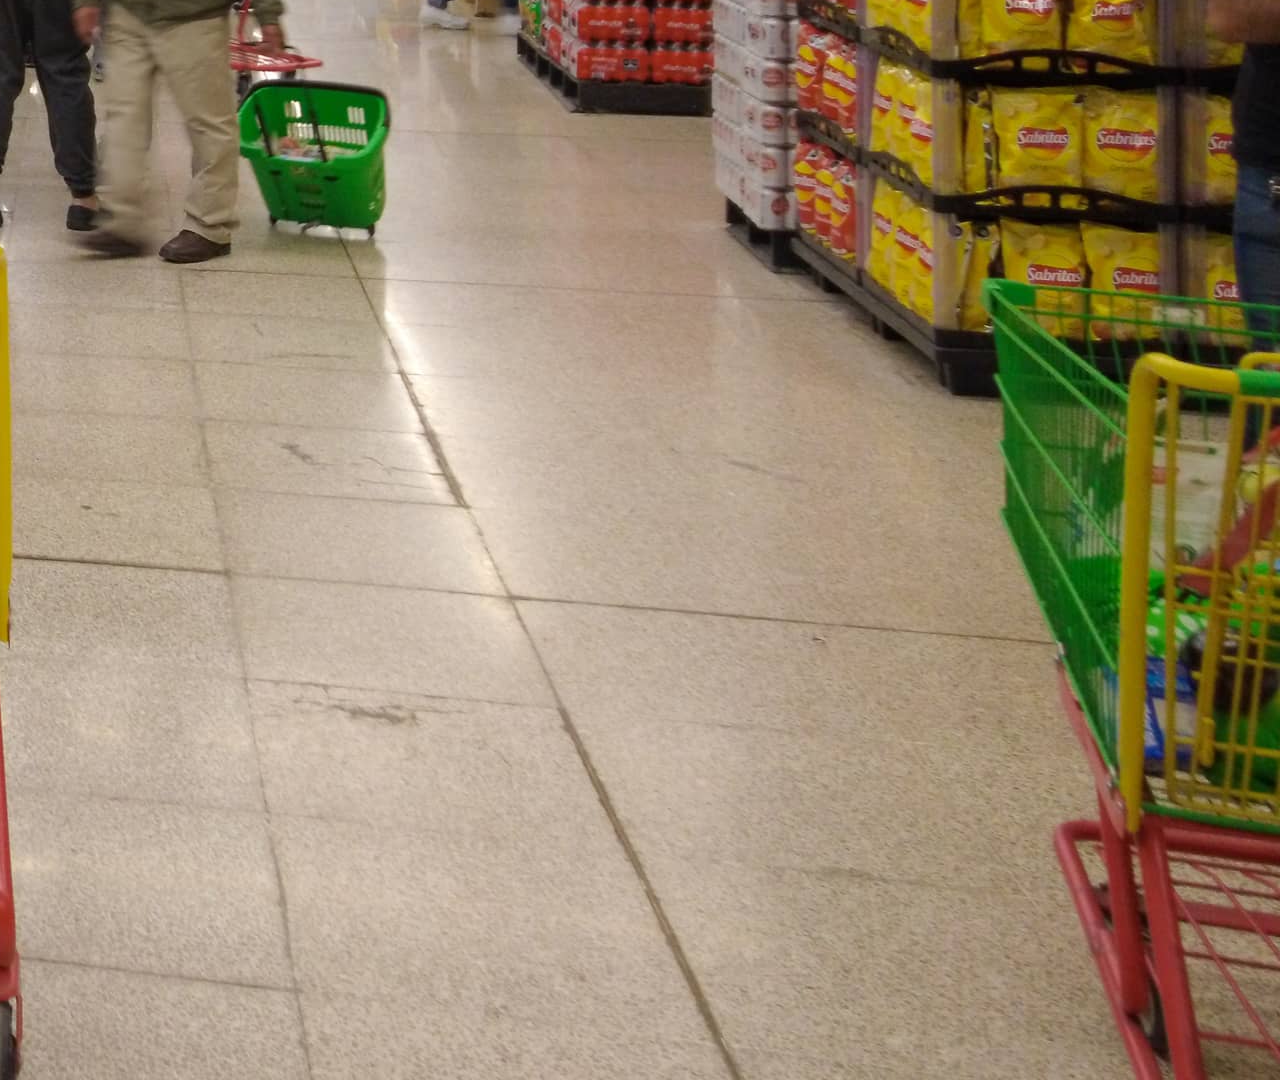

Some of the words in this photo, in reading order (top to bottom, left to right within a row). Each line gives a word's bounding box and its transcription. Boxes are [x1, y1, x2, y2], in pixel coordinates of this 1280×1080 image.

[1017, 130, 1069, 145] Sabritas
[1027, 267, 1082, 282] Sabritas
[1112, 270, 1159, 286] Sabrit
